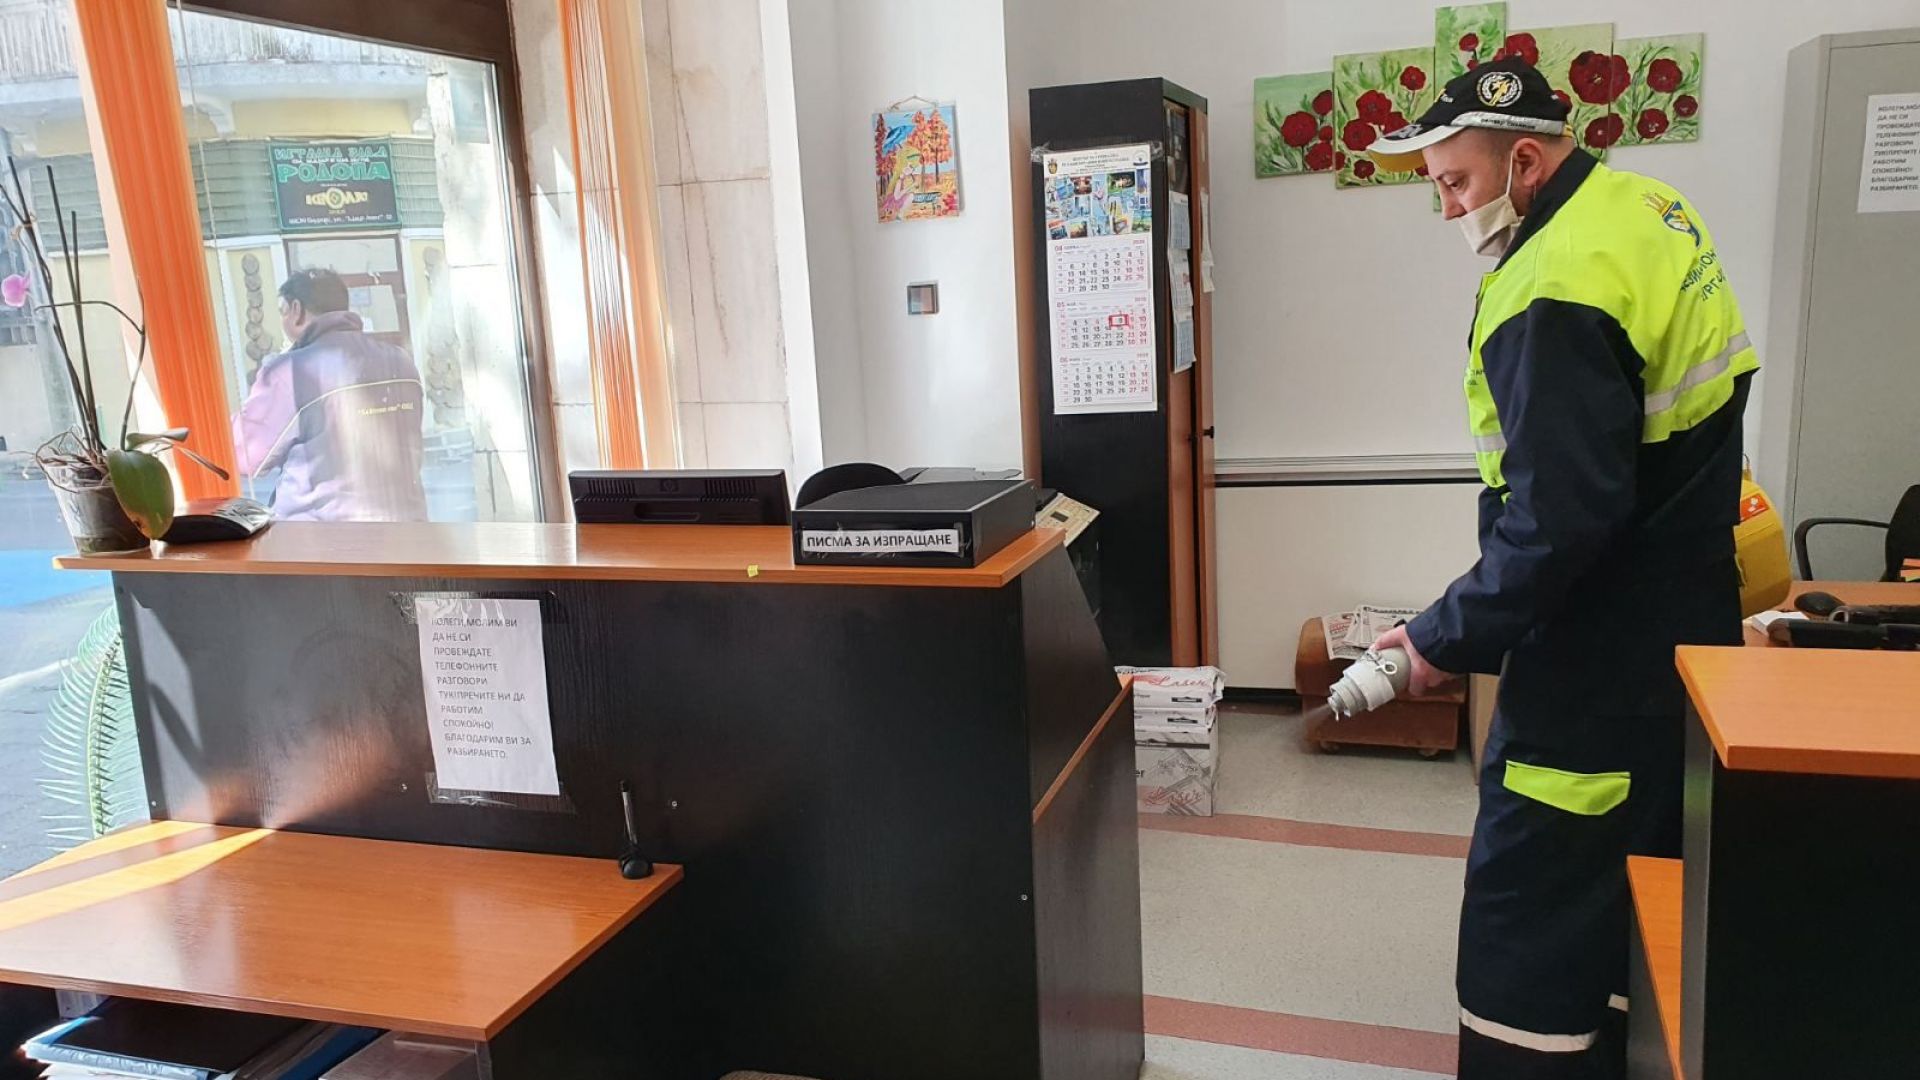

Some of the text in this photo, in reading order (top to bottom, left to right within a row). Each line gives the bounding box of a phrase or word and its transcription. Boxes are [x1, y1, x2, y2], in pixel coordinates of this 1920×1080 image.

[277, 161, 391, 183] РОДОПА
[807, 534, 952, 548] ПИСМА ЗА ИЗПРАЩАНЕ
[505, 618, 518, 628] ВИ
[432, 632, 472, 642] ДА НЕ СИ
[434, 647, 492, 658] ПРОВЕЖДАТЕ
[435, 661, 498, 672] ТЕЛЕФОННИТЕ
[436, 676, 488, 685] РАЗГОВОРИ
[497, 692, 511, 701] НИ
[513, 692, 526, 702] ДА
[441, 705, 483, 715] РАБОТИМ
[443, 719, 494, 731] СПОКОЙНО!
[444, 733, 532, 745] БЛАГОДАРИМ ВИ ЗА
